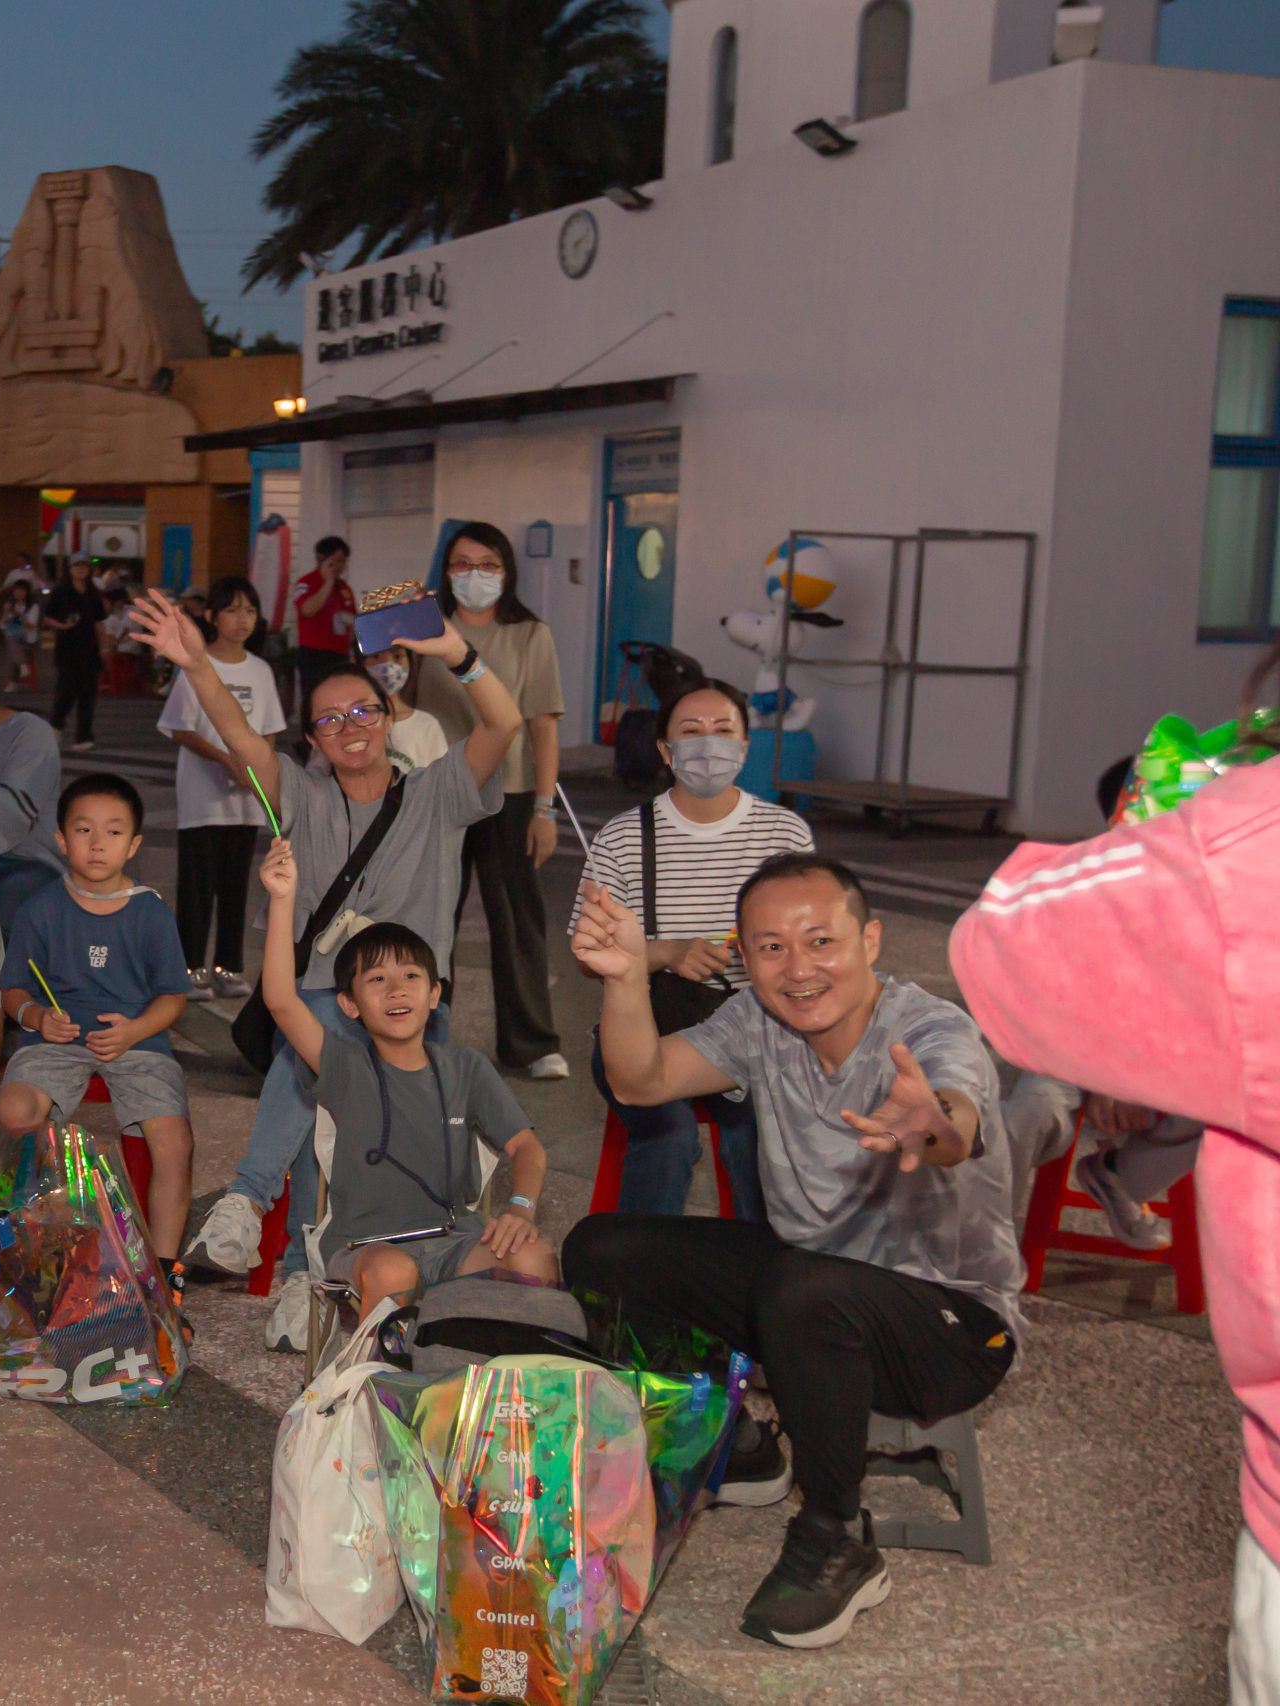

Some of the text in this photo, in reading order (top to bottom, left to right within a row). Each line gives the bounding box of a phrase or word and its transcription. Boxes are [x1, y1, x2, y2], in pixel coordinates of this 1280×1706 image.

[353, 330, 395, 356] Service
[400, 322, 444, 347] Center
[89, 945, 109, 957] FAS
[90, 956, 107, 968] TER
[476, 1608, 536, 1627] Contrel
